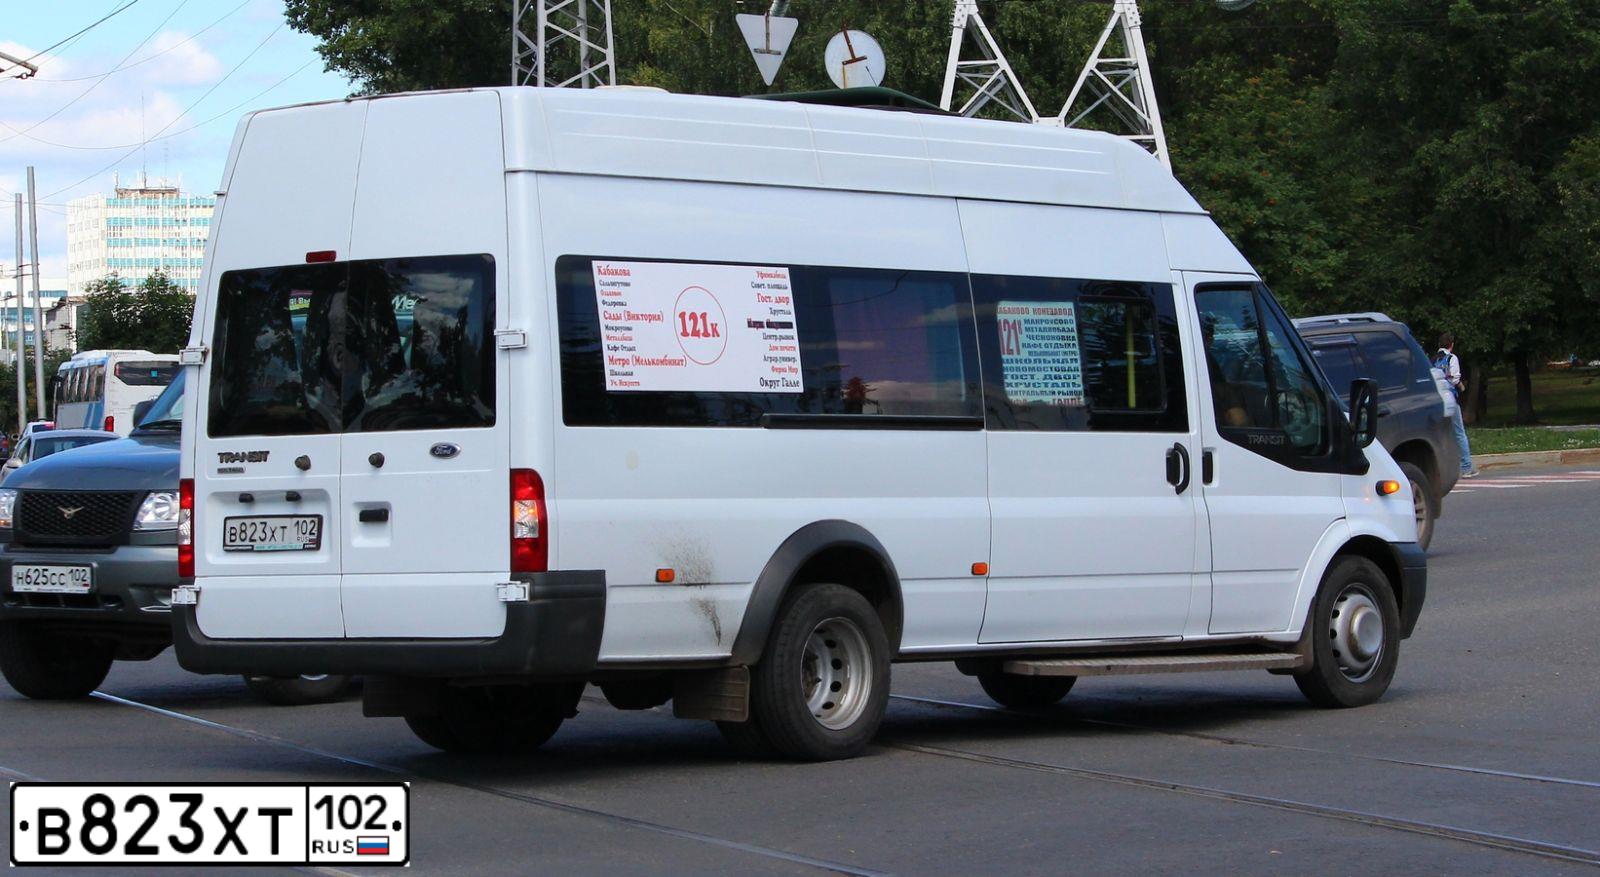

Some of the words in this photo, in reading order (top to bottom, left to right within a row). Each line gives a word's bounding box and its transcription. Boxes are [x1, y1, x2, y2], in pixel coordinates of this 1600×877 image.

[597, 264, 631, 276] Кабакова
[757, 293, 773, 303] Гост.
[775, 296, 790, 305] двор
[603, 310, 622, 321] Сады
[624, 310, 664, 323] (Виктория)
[607, 343, 619, 352] Кафе
[608, 354, 630, 368] Метро
[632, 354, 687, 368] (Мелькомбинат)
[760, 377, 780, 389] Округ
[781, 377, 800, 387] Галле
[1248, 434, 1286, 445] TRANSIT
[217, 450, 270, 464] TRANSIT
[294, 519, 316, 536] 102
[68, 568, 88, 582] 102
